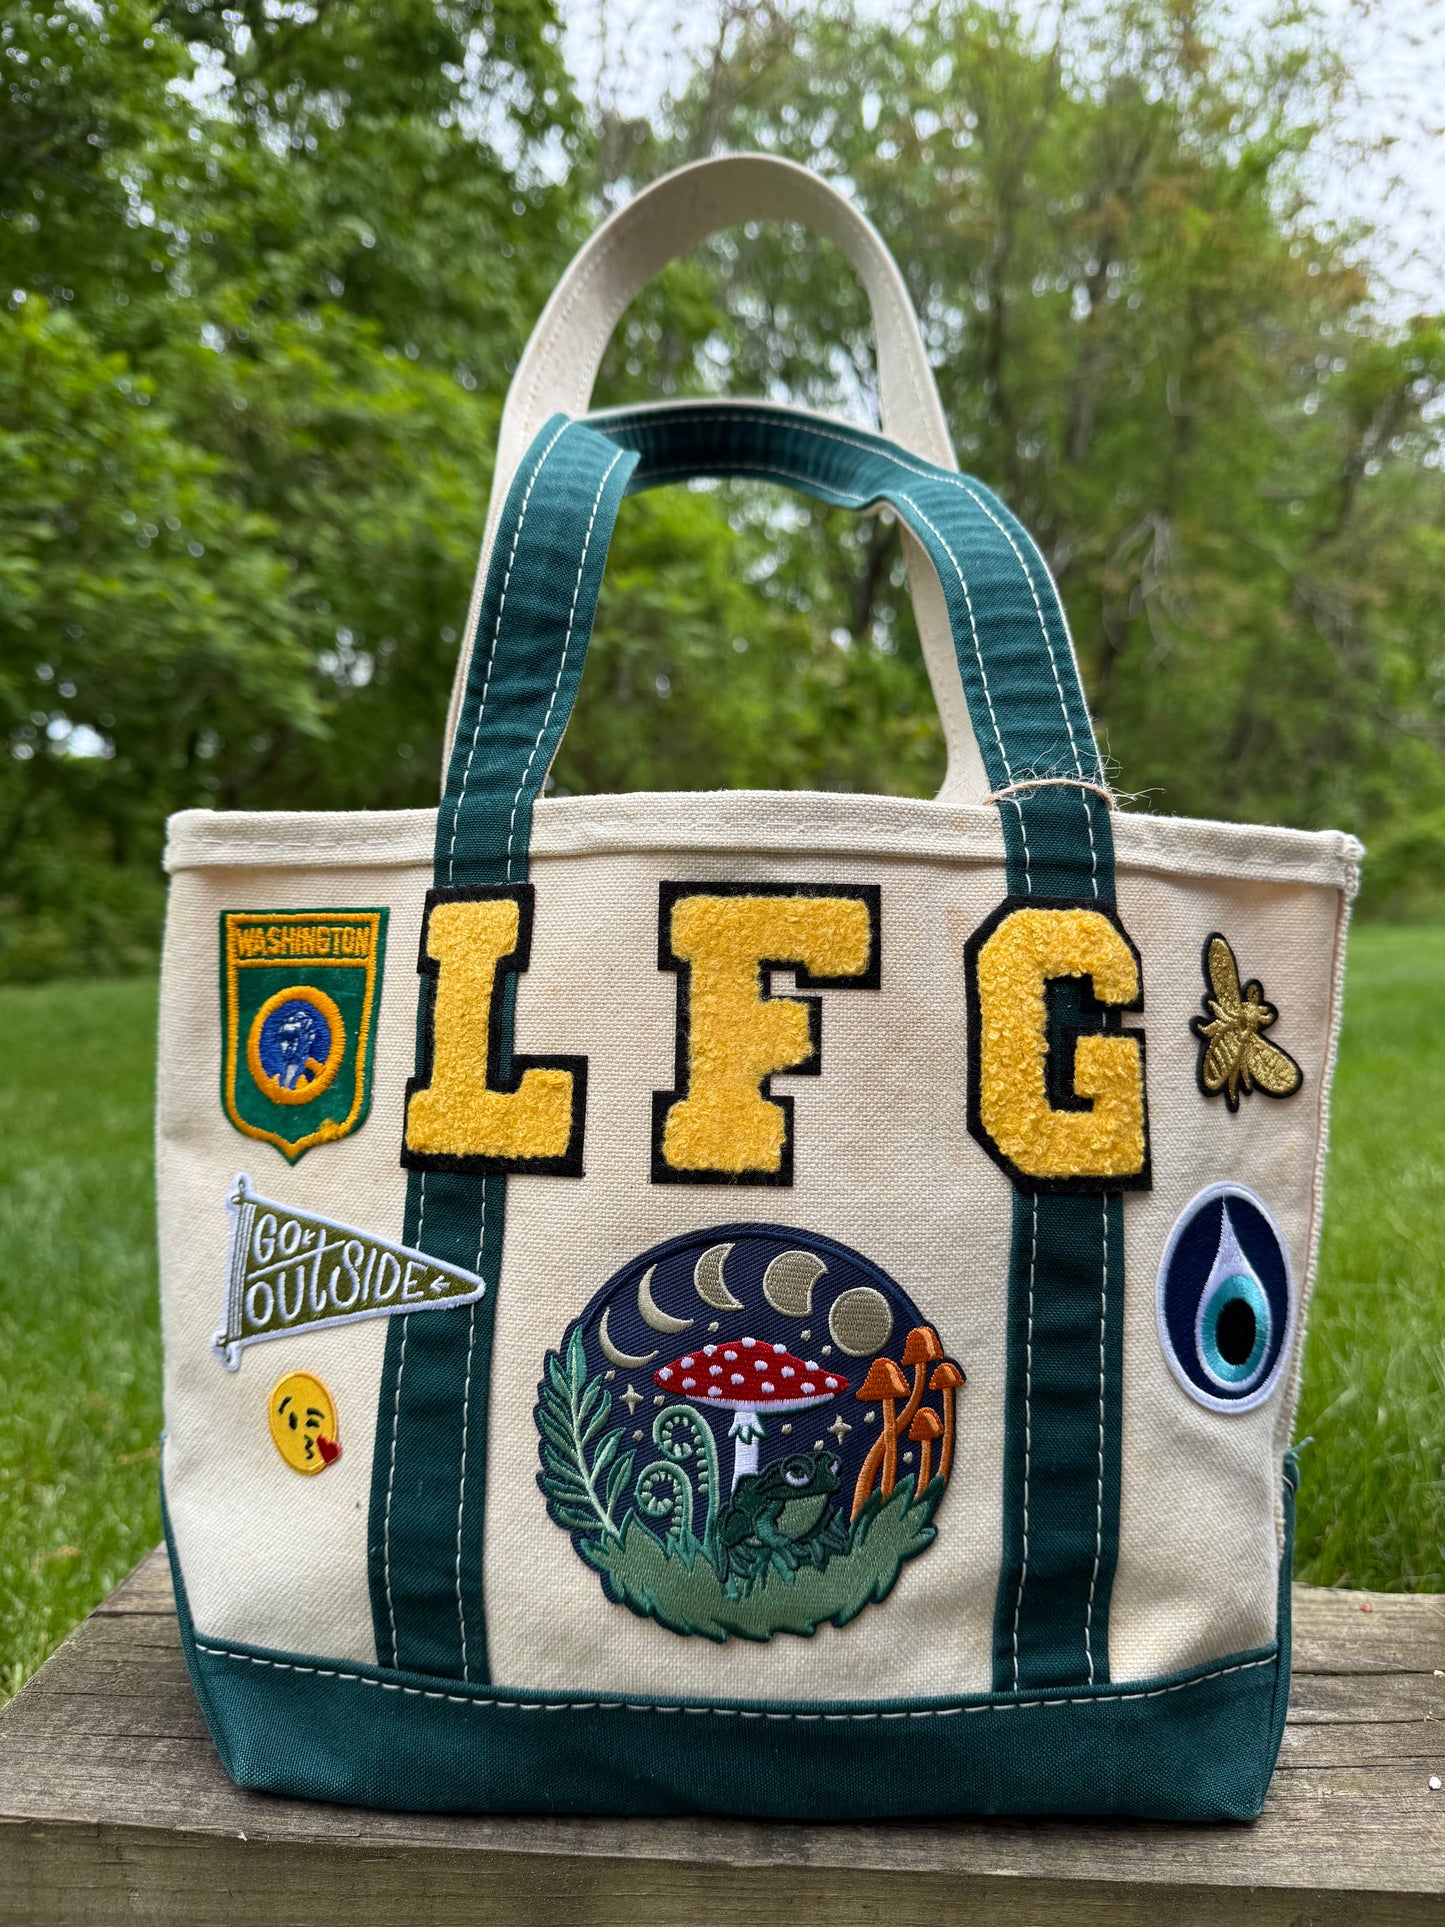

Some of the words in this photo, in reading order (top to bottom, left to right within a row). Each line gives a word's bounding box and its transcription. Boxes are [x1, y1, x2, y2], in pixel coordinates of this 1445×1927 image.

[237, 926, 370, 955] WASHINGTON
[402, 881, 1152, 1191] LFG
[254, 1213, 301, 1264] GO
[246, 1228, 428, 1326] OUTSIDE
